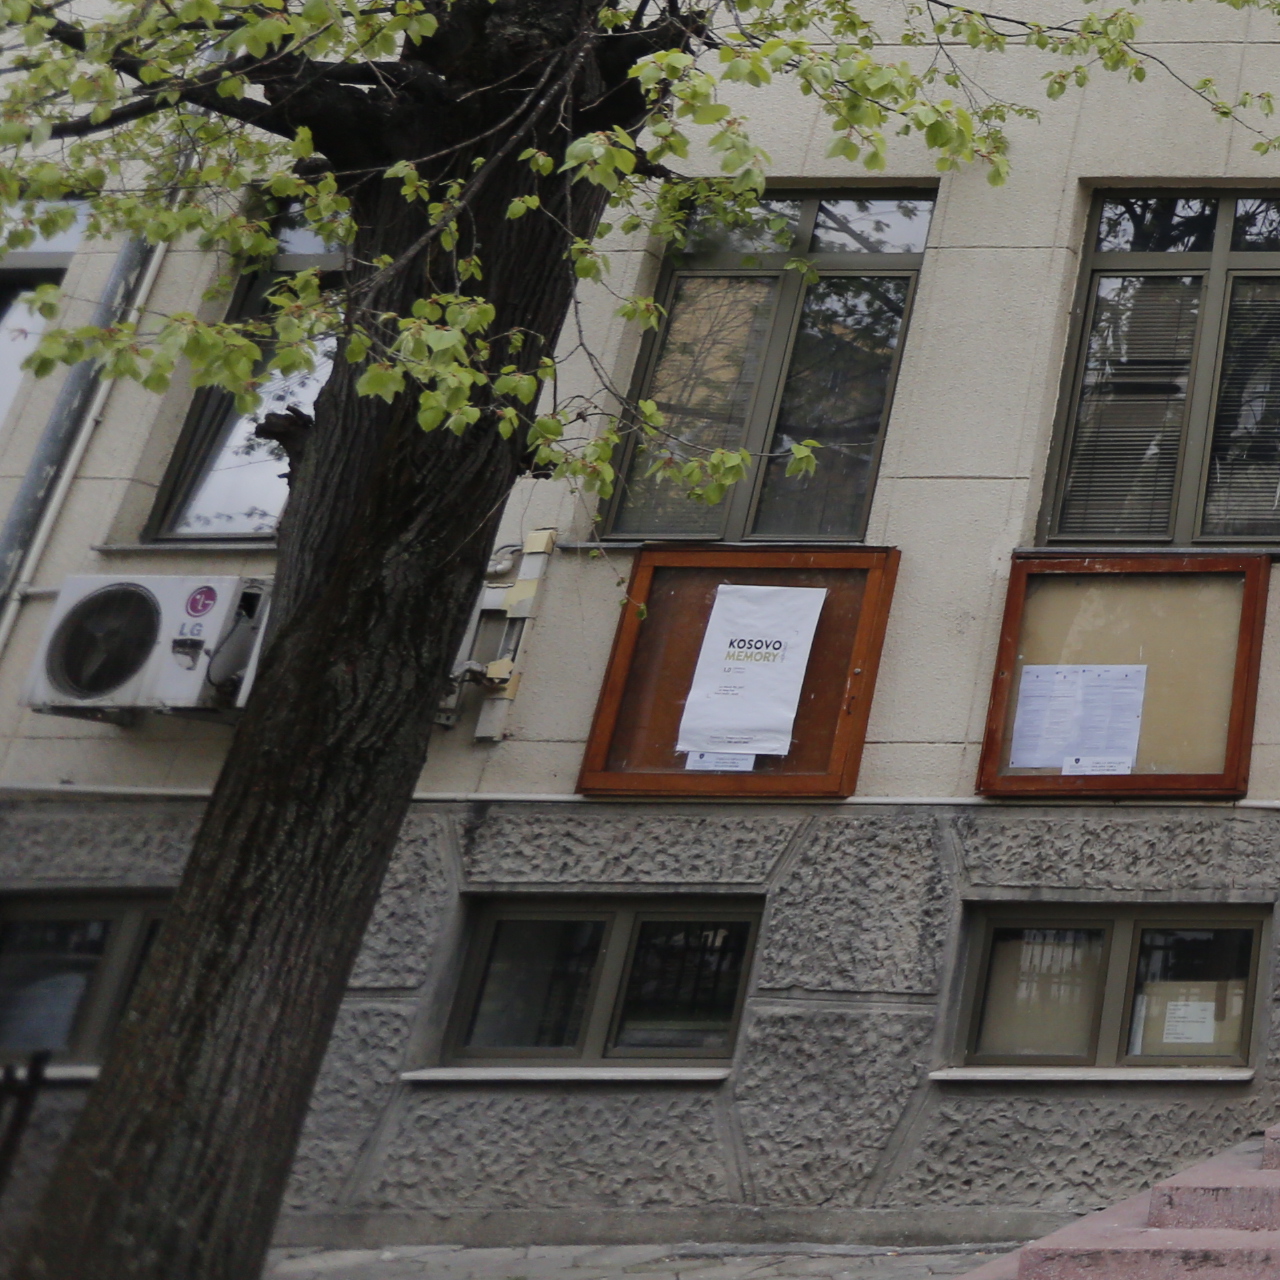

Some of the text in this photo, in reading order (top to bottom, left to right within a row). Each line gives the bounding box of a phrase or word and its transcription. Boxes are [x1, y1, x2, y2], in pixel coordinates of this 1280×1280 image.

[179, 623, 203, 636] LG
[728, 638, 782, 651] KOSOVO
[724, 650, 780, 663] MEMORY
